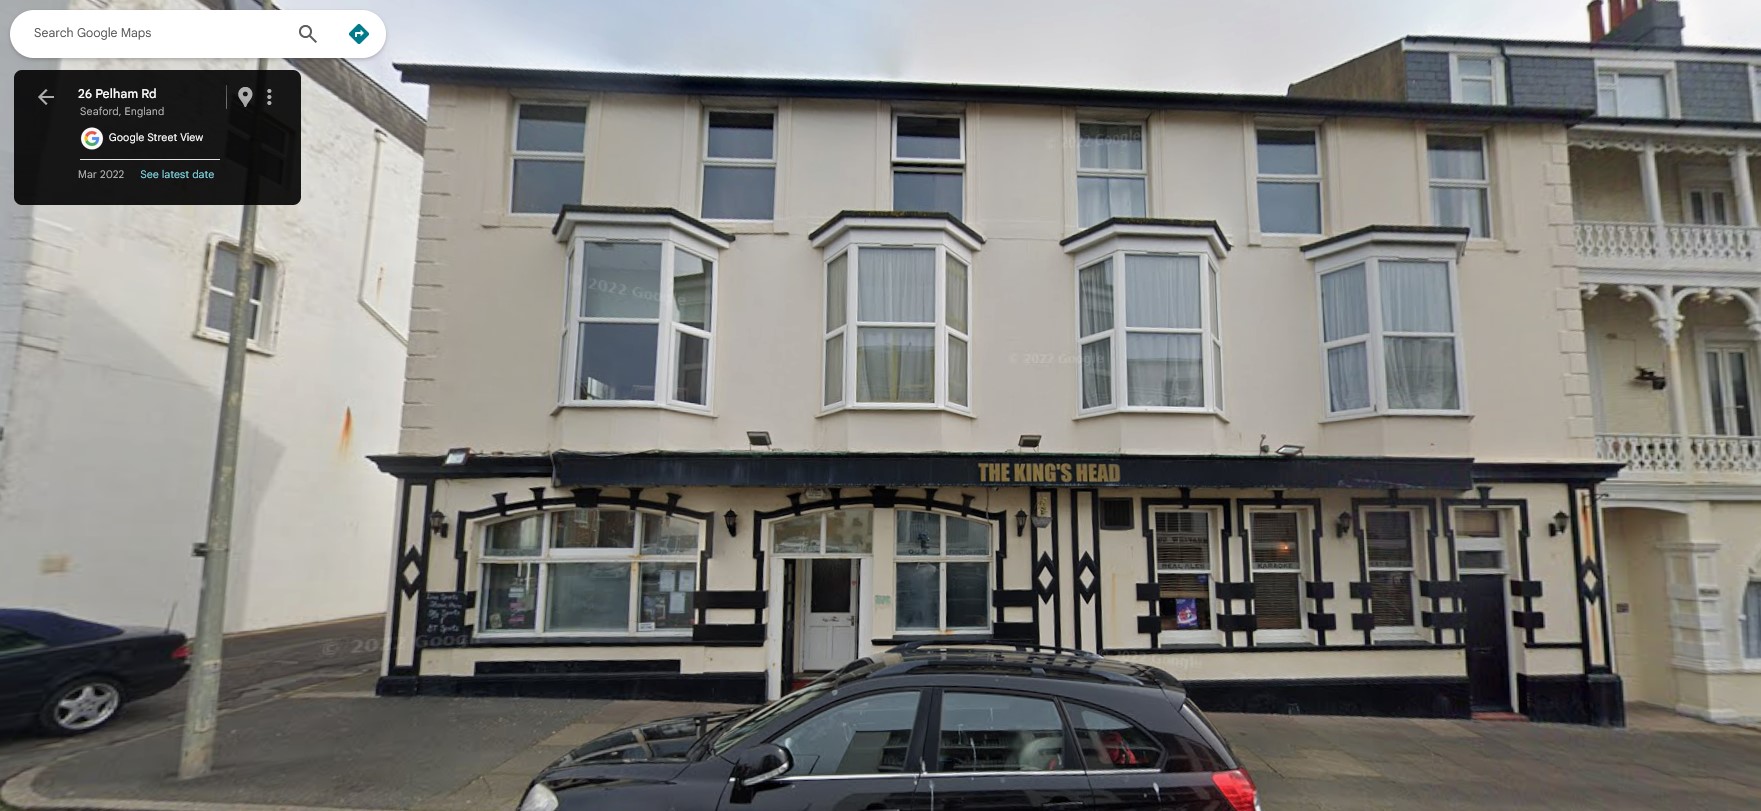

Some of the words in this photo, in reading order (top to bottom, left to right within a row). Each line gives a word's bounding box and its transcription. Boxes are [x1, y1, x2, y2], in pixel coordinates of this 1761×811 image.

[978, 463, 1011, 482] THE
[1014, 463, 1072, 483] KING'S
[1076, 463, 1121, 483] HEAD
